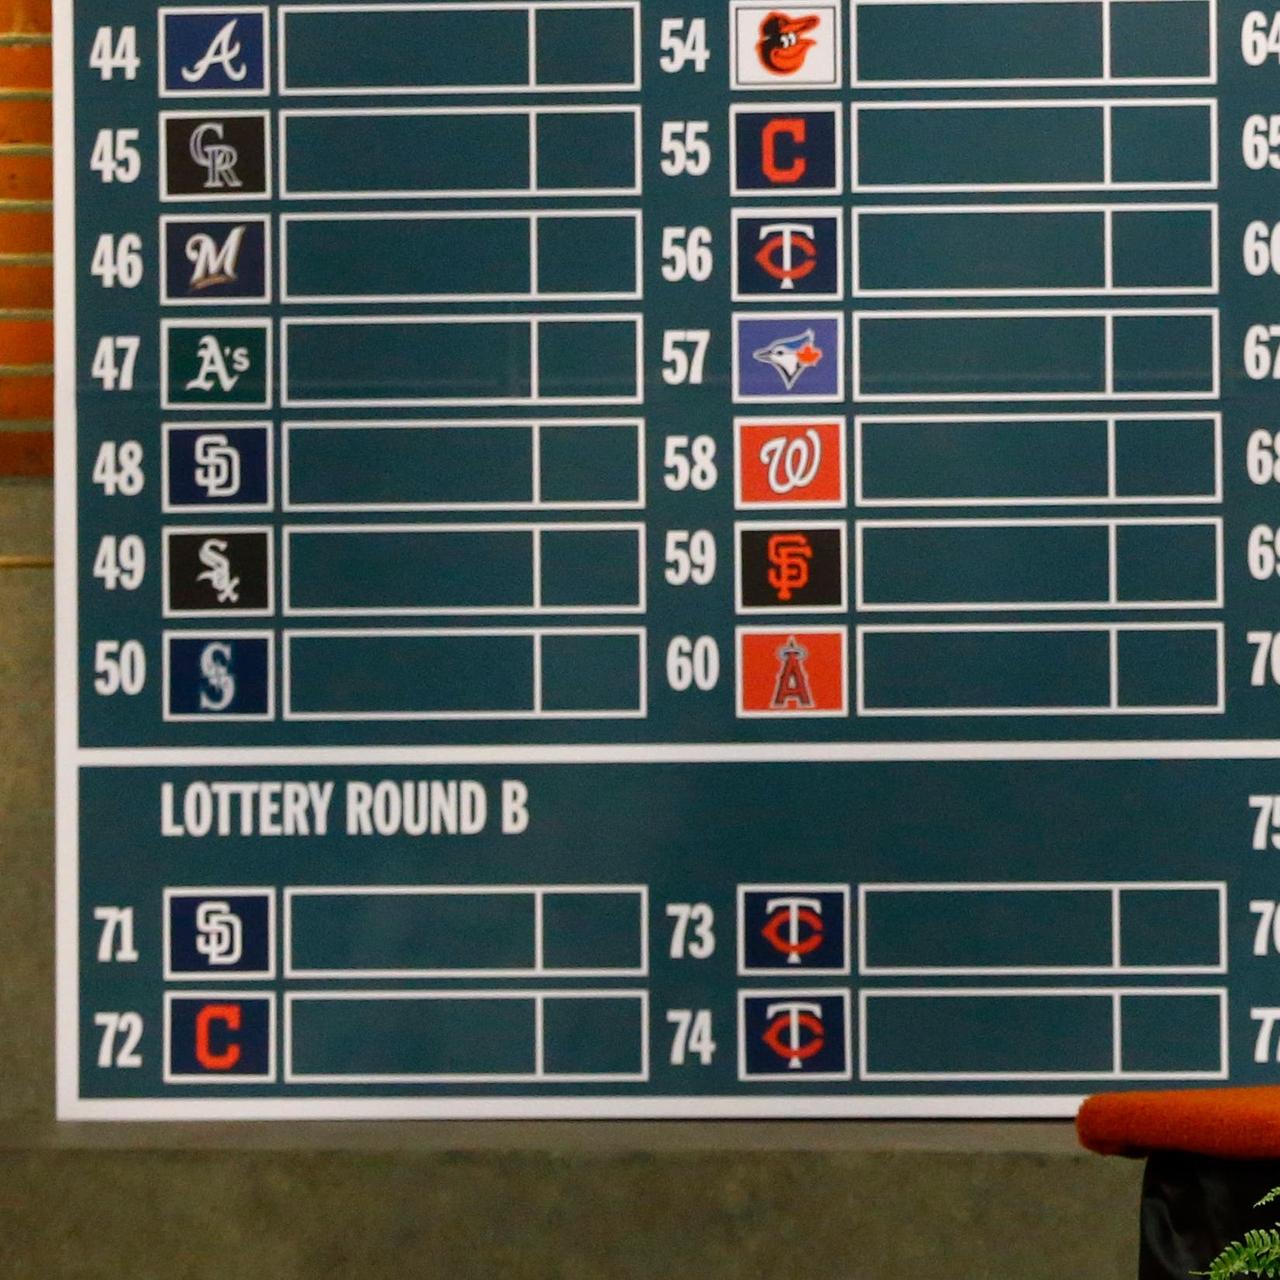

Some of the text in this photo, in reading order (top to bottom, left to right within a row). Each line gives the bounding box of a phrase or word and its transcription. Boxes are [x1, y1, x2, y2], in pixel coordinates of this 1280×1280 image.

[90, 19, 246, 82] 44 A
[660, 18, 710, 72] 54
[91, 129, 141, 182] 45
[661, 118, 806, 183] 55 C
[91, 226, 245, 288] 46 M
[662, 227, 712, 281] 56
[92, 336, 140, 390] 47
[662, 330, 710, 384] 57
[93, 441, 144, 495] 48
[664, 429, 822, 493] 58 W
[94, 535, 145, 589] 49
[665, 530, 716, 585] 59
[95, 641, 145, 695] 50
[667, 636, 719, 690] 60
[161, 781, 529, 837] LOTTERY ROUND B
[95, 907, 138, 961] 71
[667, 904, 714, 958] 73
[95, 1004, 241, 1070] 72 C
[667, 1010, 715, 1064] 74
